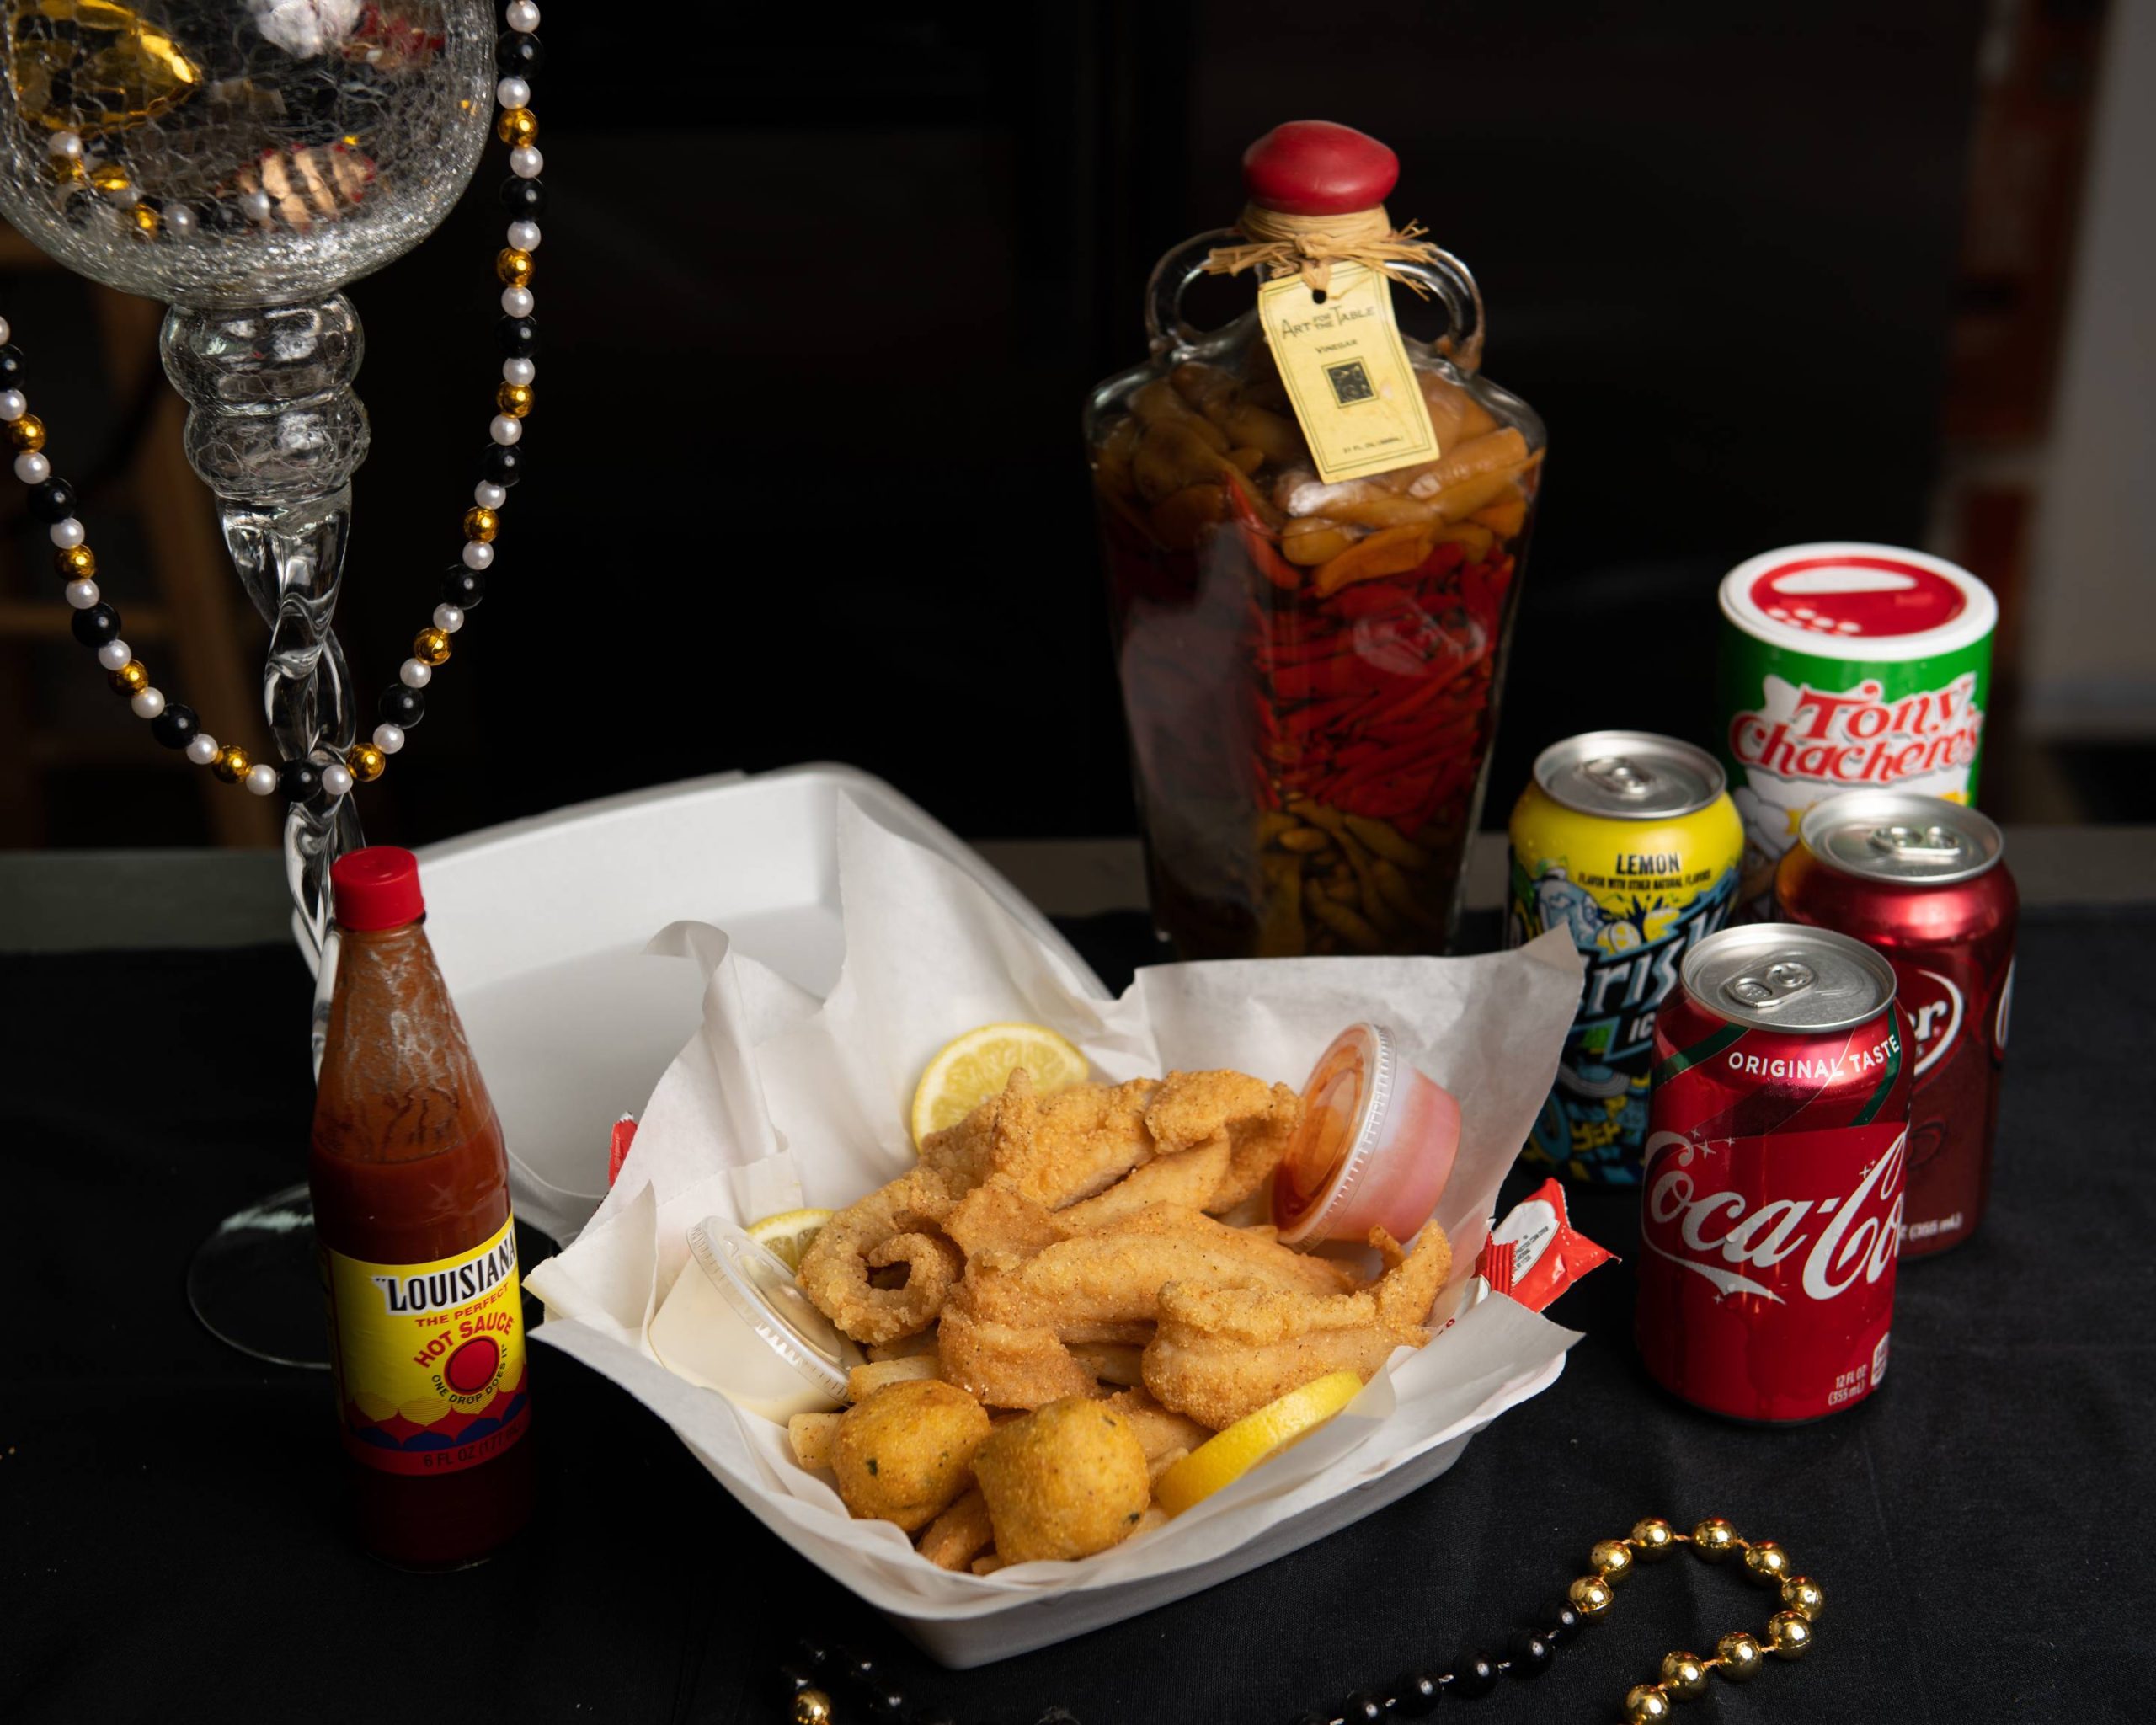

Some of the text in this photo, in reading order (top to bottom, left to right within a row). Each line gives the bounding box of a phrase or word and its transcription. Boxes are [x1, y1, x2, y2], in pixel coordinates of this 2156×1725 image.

[1616, 852, 1680, 875] LEMON
[1728, 1051, 1844, 1079] ORIGINAL
[1849, 1034, 1900, 1073] TASTE
[415, 1282, 509, 1328] THE PERFECT
[413, 1311, 513, 1369] HOT SAUCE
[431, 1374, 450, 1397] ONE
[448, 1393, 483, 1405] DROP
[485, 1362, 506, 1395] DOES
[424, 1454, 433, 1467] 6
[437, 1451, 454, 1466] FL
